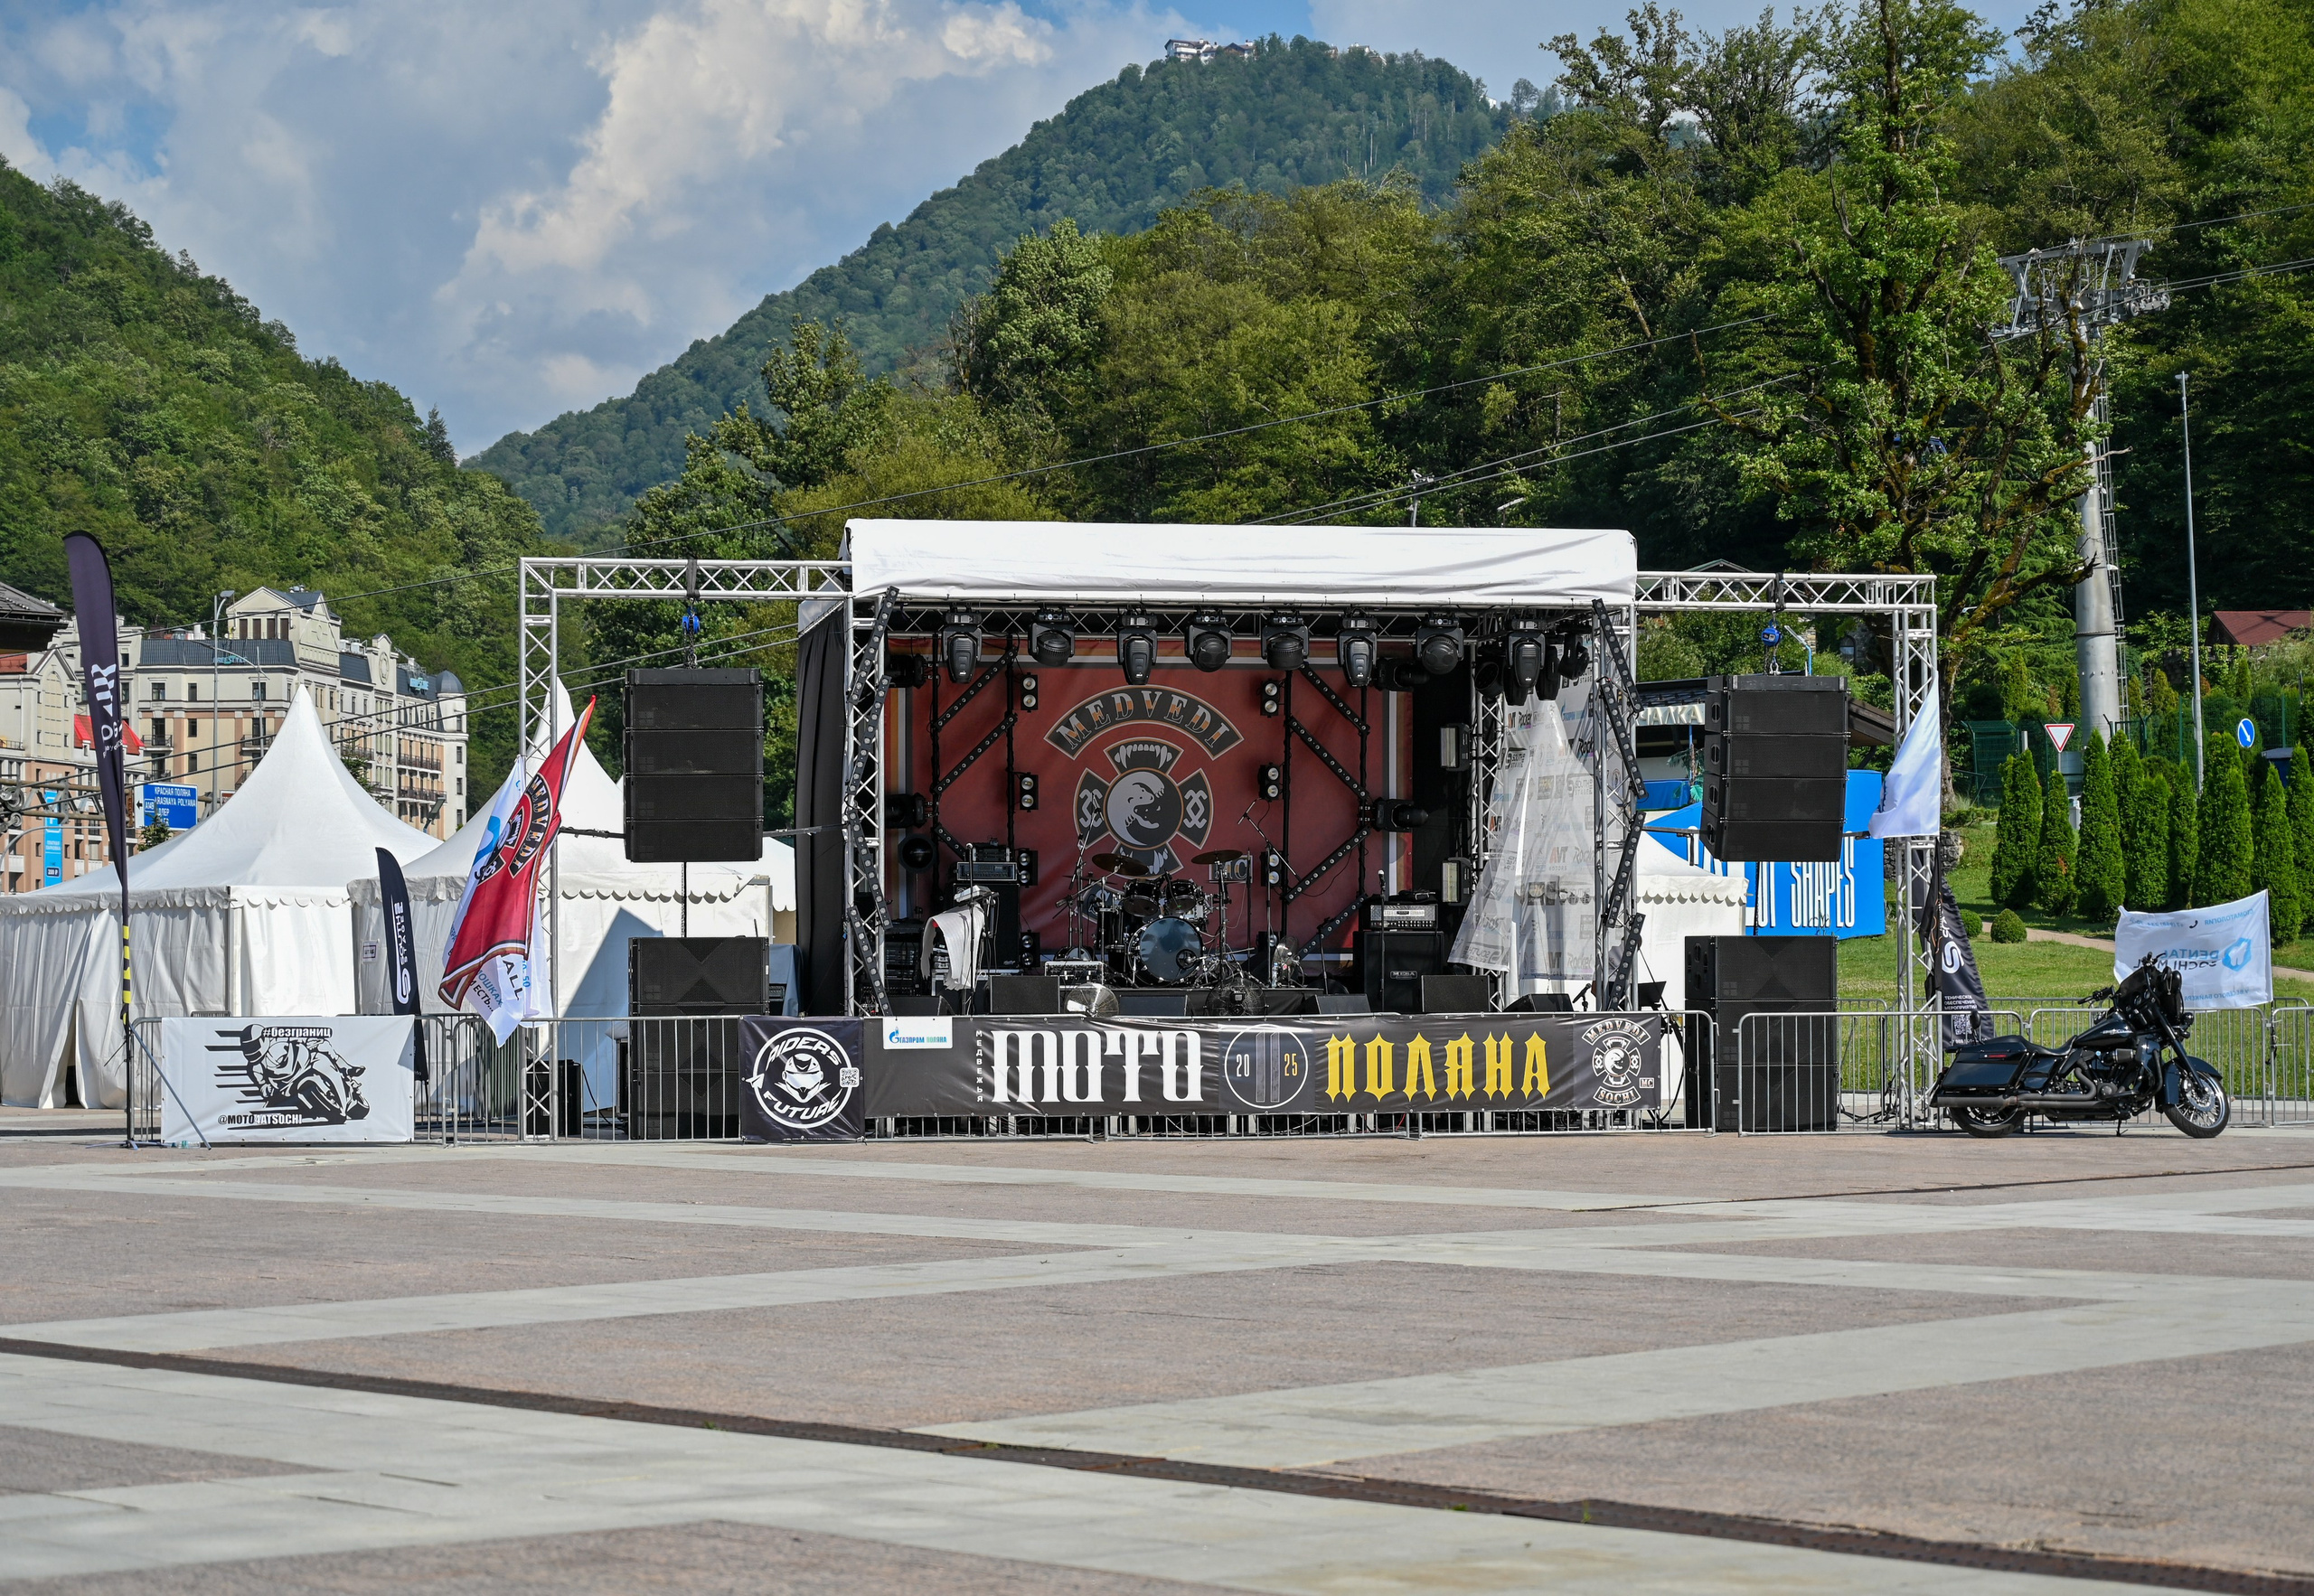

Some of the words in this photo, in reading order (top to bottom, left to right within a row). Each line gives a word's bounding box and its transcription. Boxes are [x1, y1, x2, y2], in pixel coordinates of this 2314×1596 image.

[1056, 690, 1230, 750] MEDVEDI
[1634, 705, 1703, 726] ЧАЛКА
[155, 786, 174, 795] КРАСНАЯ
[174, 788, 191, 797] ПОЛЯНА
[513, 776, 549, 869] MEDVEDI
[1790, 831, 1855, 928] SHAPES
[501, 954, 523, 1001] ALL
[262, 1027, 332, 1038] #безграниц
[1586, 1020, 1646, 1042] MEDVEDI
[766, 1036, 842, 1071] RIDERS
[975, 1029, 984, 1103] МЕДВЕЖЬЯ
[1236, 1054, 1250, 1077] 20
[1284, 1053, 1298, 1076] 25
[1324, 1030, 1550, 1103] ПОЛЯНА
[1597, 1089, 1636, 1103] SOCHI
[1641, 1078, 1654, 1087] MC
[763, 1087, 842, 1121] FUTURE
